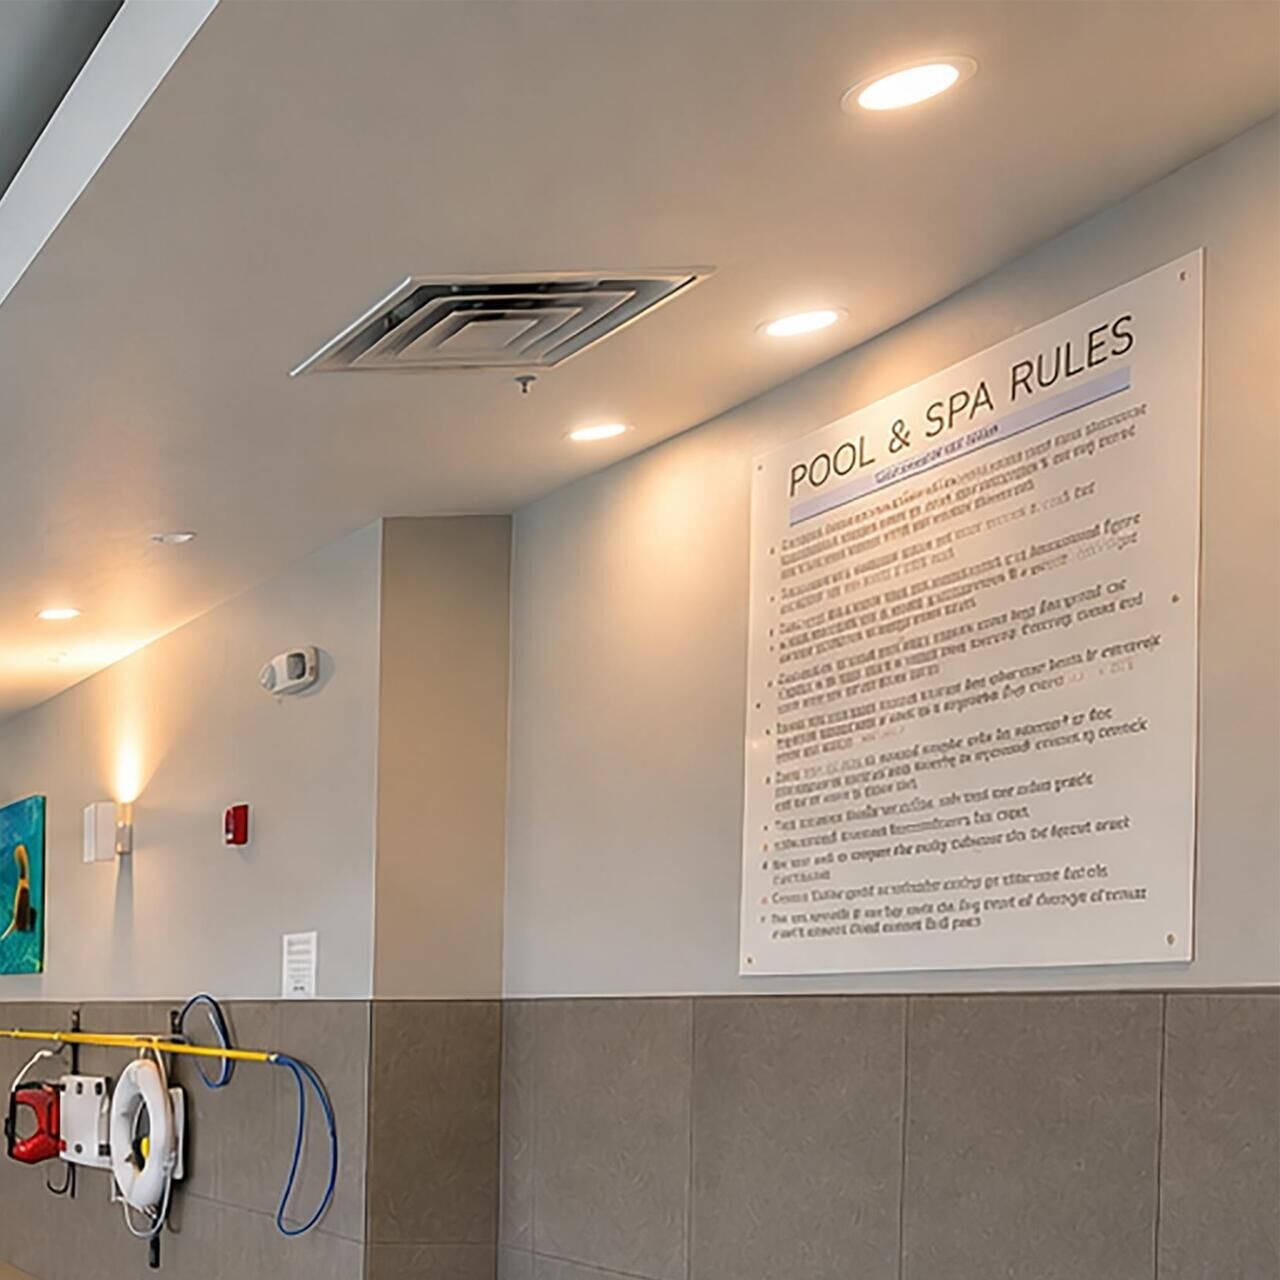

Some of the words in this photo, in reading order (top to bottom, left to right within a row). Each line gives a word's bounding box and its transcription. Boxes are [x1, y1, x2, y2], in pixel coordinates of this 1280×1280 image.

[789, 435, 875, 497] POOL
[888, 418, 911, 454] &
[925, 381, 994, 438] SPA
[1011, 315, 1134, 402] RULES
